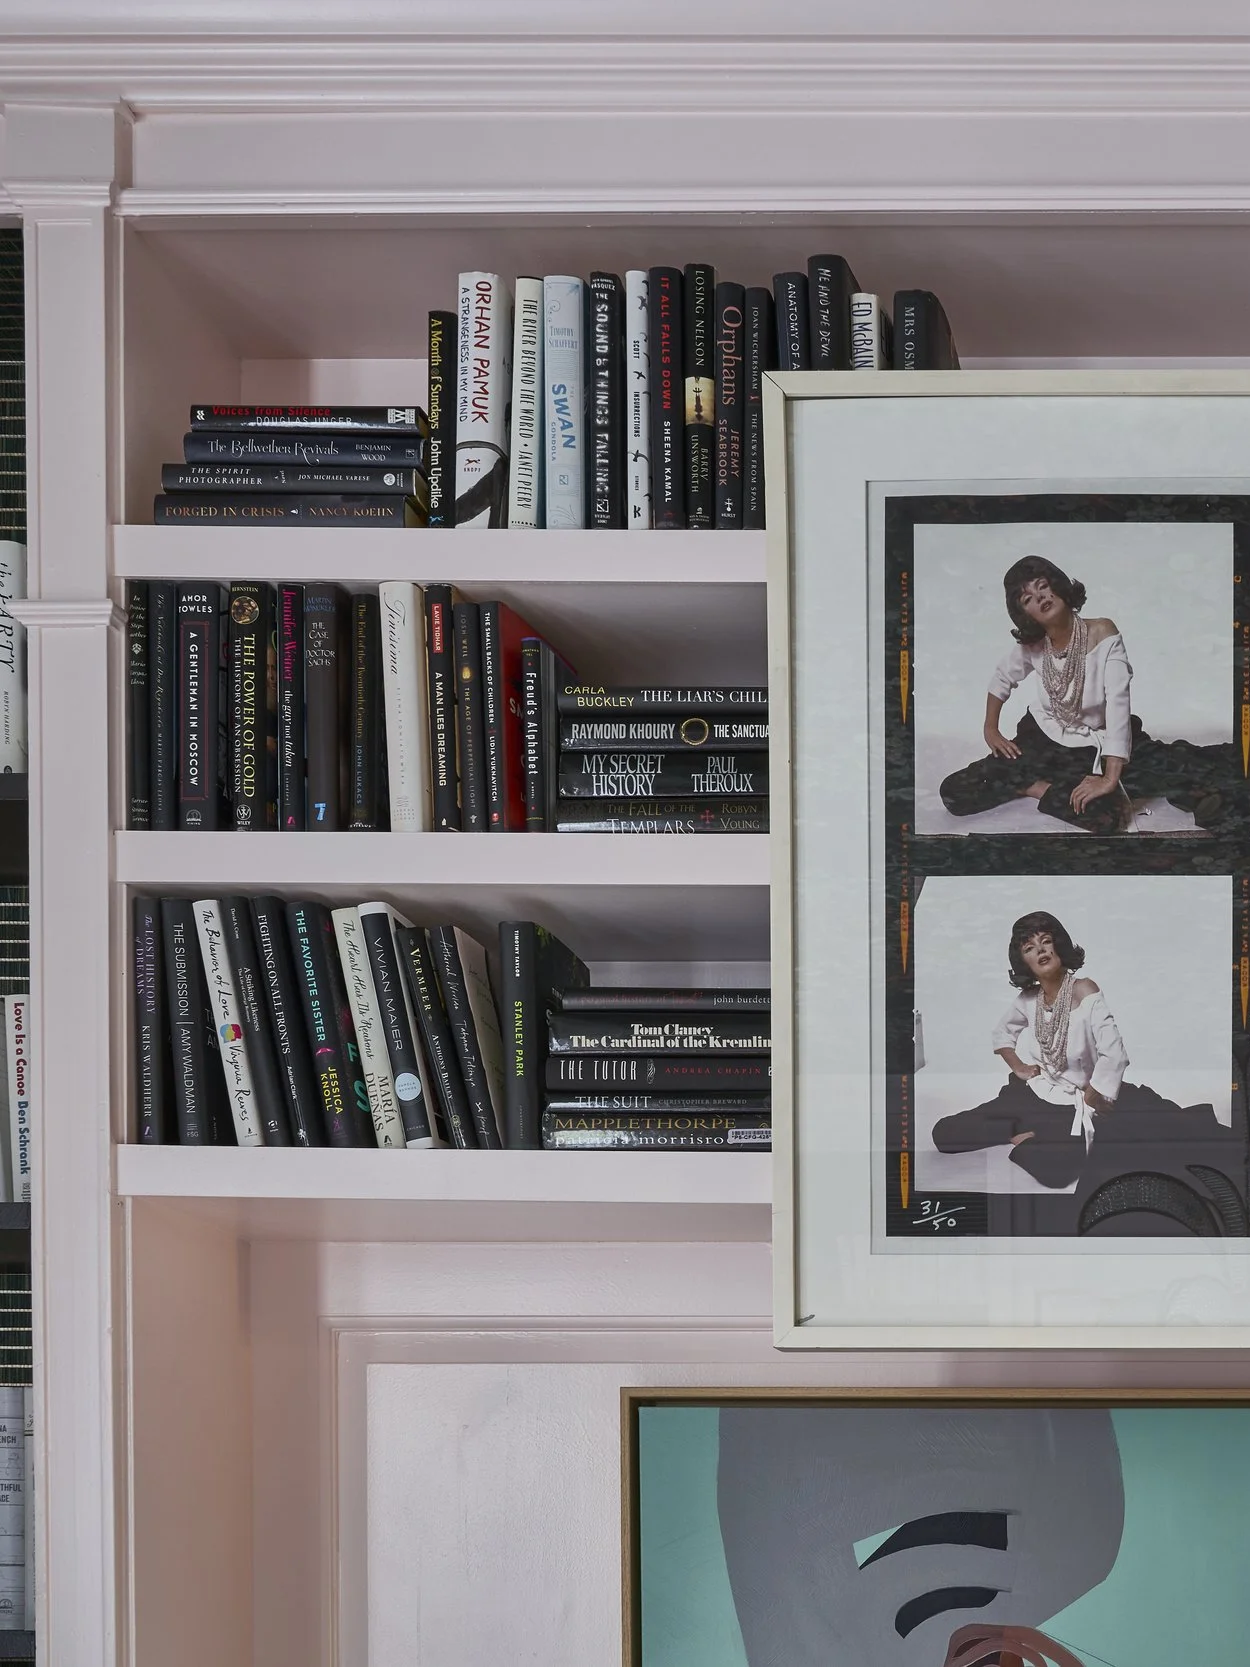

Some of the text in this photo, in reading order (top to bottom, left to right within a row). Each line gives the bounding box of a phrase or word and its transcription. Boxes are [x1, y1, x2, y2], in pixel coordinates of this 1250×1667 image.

[660, 277, 668, 287] IT
[431, 319, 441, 327] A
[661, 295, 669, 318] ALL
[695, 270, 704, 366] LOSING NELSON
[818, 268, 831, 357] ME AND THE DEVIL
[431, 330, 441, 366] Month
[471, 281, 492, 423] ORHAN PAMUK
[661, 324, 670, 364] FALLS
[852, 302, 874, 369] ED McBAIN
[717, 306, 742, 405] Orphans
[430, 384, 441, 429] Sundays
[662, 370, 671, 409] DOWN
[552, 384, 576, 449] SWAN
[430, 437, 441, 461] John
[719, 419, 727, 486] SEABROOK
[730, 429, 739, 477] JEREMY
[430, 464, 441, 508] Updike
[166, 506, 394, 518] FORGED IN CRISIS NANCY KOEHN
[189, 644, 198, 711] GENTLEMAN
[641, 691, 767, 702] THE LIAR'S CHIL
[243, 634, 255, 797] THE POWER OF GOLD
[578, 697, 634, 706] BUCKLEY
[189, 717, 197, 727] IN
[525, 673, 538, 775] Freud's Alphabet
[572, 724, 675, 738] RAYMOND KHOURY
[189, 734, 197, 786] MOSCOW
[437, 733, 446, 786] DREAMING
[582, 755, 665, 773] MY SECRET
[707, 757, 738, 773] PAUL
[593, 774, 655, 796] HISTORY
[691, 774, 753, 792] THEROUX
[295, 911, 325, 1041] THE FAVORITE SISTER
[374, 938, 402, 1051] VIVIAN MAIER
[14, 1003, 25, 1031] Love
[173, 923, 196, 1113] THE SUBMISSION AMY WALDMAN
[202, 910, 251, 1121] The Behavior of Love Virginia Reeves
[631, 1024, 713, 1036] Tom Clancy
[15, 1034, 25, 1044] Is
[515, 1001, 524, 1077] STANLEY PARK
[570, 1036, 771, 1048] The Cardinal of the Kremlin
[17, 1059, 26, 1096] Canoe
[560, 1060, 637, 1080] THE TUTOR
[320, 1073, 332, 1111] KNOLL
[328, 1067, 343, 1114] JESSICA
[18, 1101, 28, 1124] Ben
[556, 1119, 736, 1129] MAPPLETHORPE
[19, 1128, 30, 1174] Schrank
